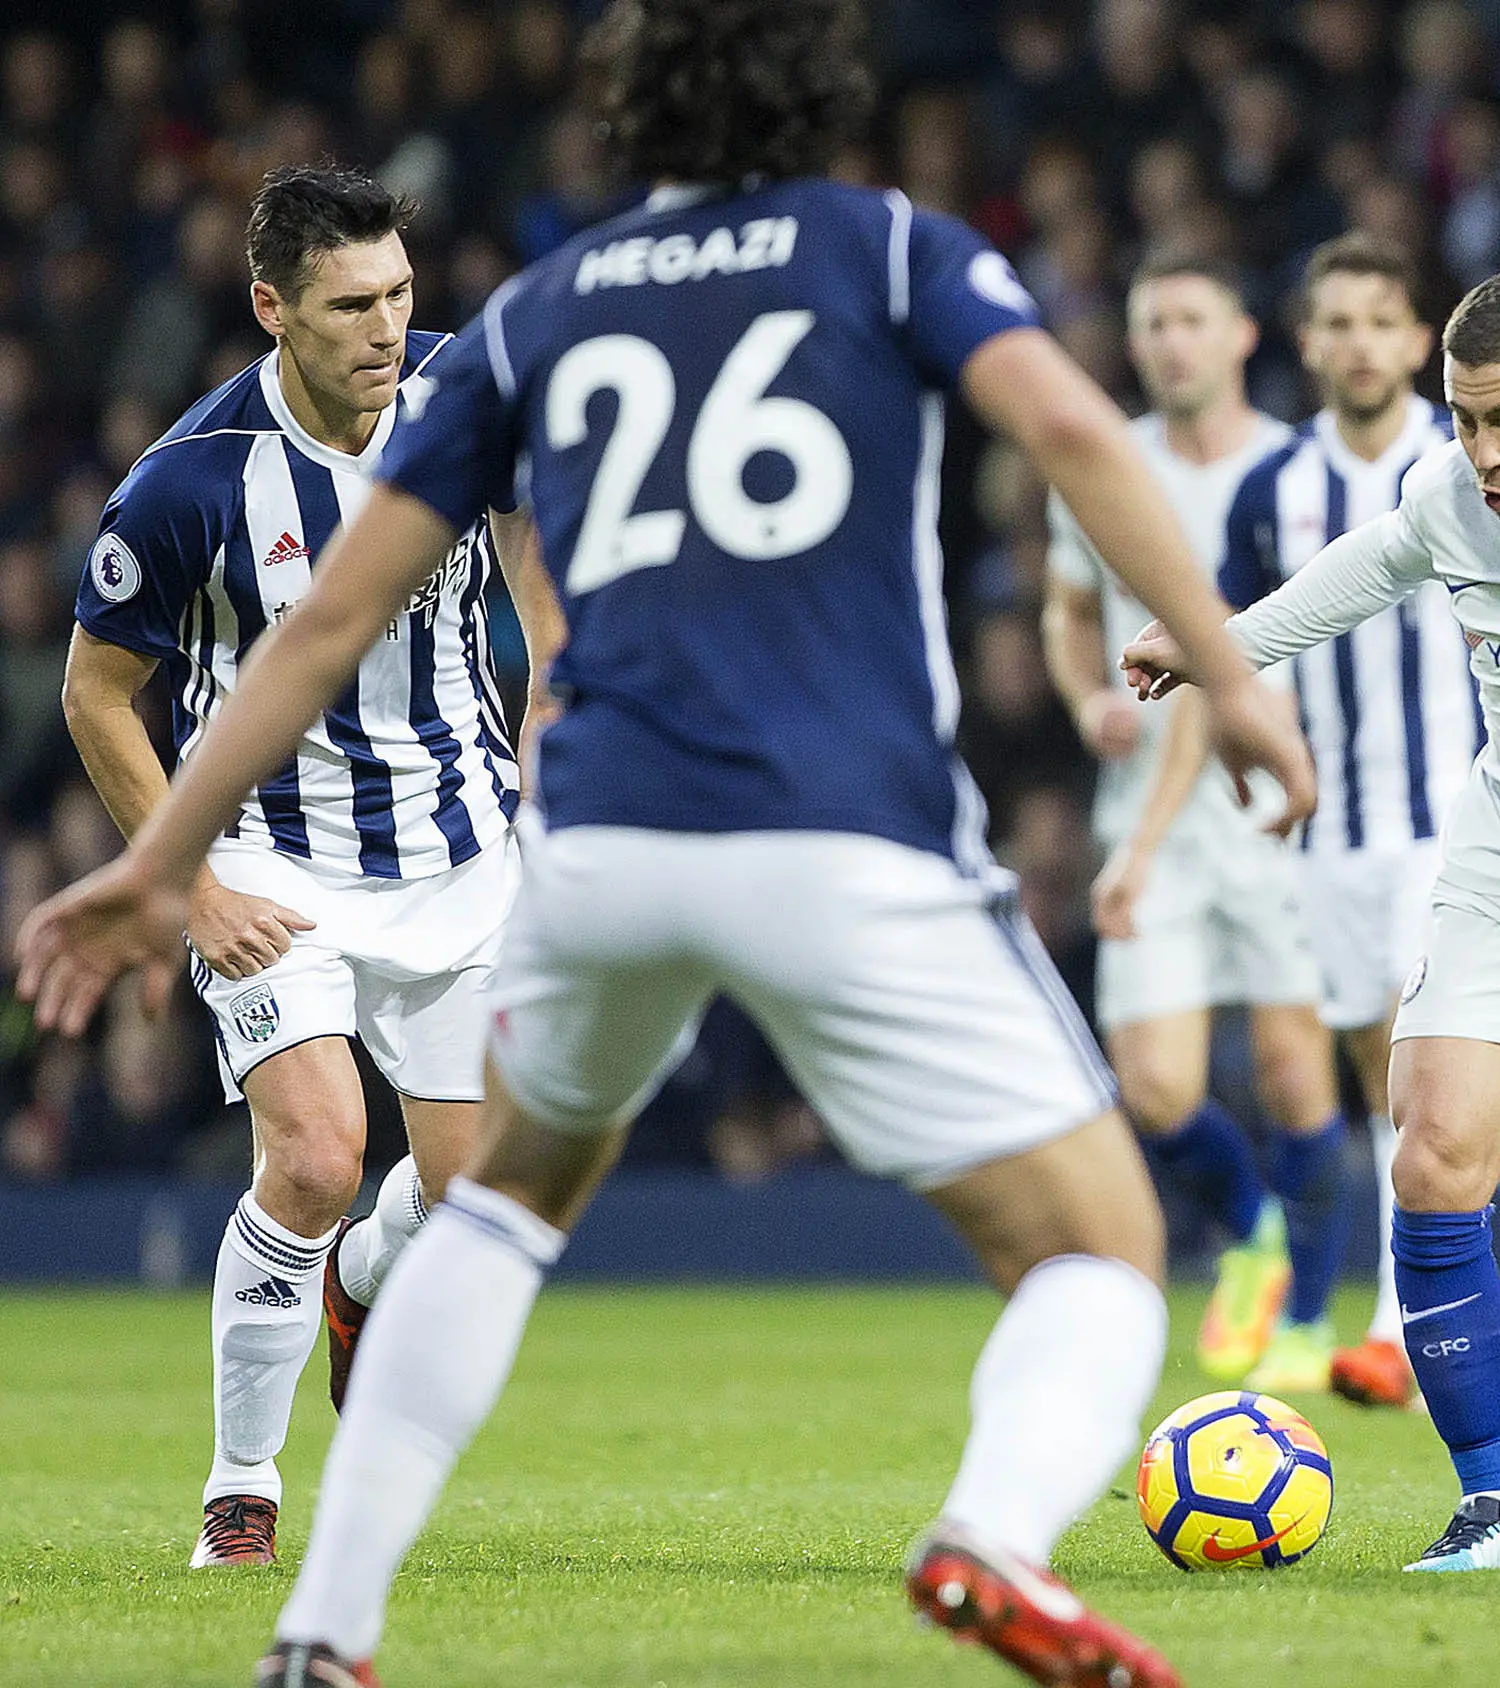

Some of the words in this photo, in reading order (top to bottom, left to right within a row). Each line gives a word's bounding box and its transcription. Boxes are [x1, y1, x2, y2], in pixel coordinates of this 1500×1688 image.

[574, 216, 798, 294] HEGAZI
[545, 309, 855, 597] 26
[264, 546, 311, 567] adidas
[234, 1288, 302, 1309] adidas
[1422, 1336, 1471, 1358] CFC
